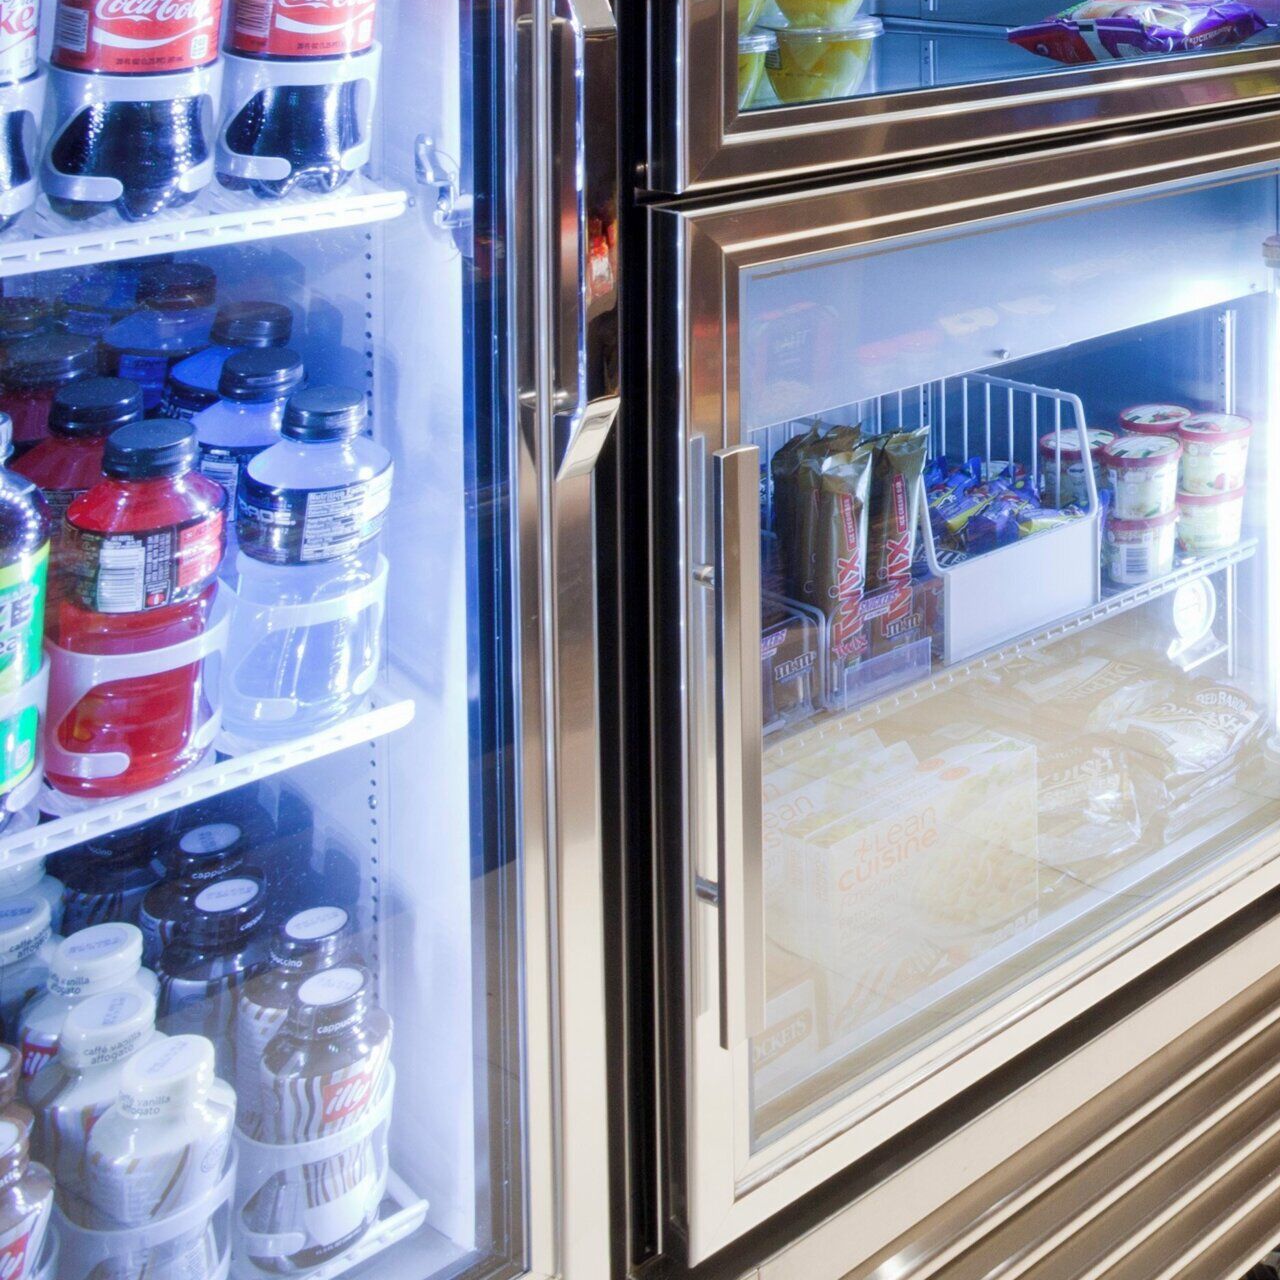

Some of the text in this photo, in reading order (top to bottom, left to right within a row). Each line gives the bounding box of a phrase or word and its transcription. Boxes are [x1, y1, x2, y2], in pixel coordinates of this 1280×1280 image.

[832, 549, 863, 646] TWIX
[875, 805, 937, 851] Lean
[837, 827, 939, 892] cuisine
[324, 1079, 371, 1116] illy
